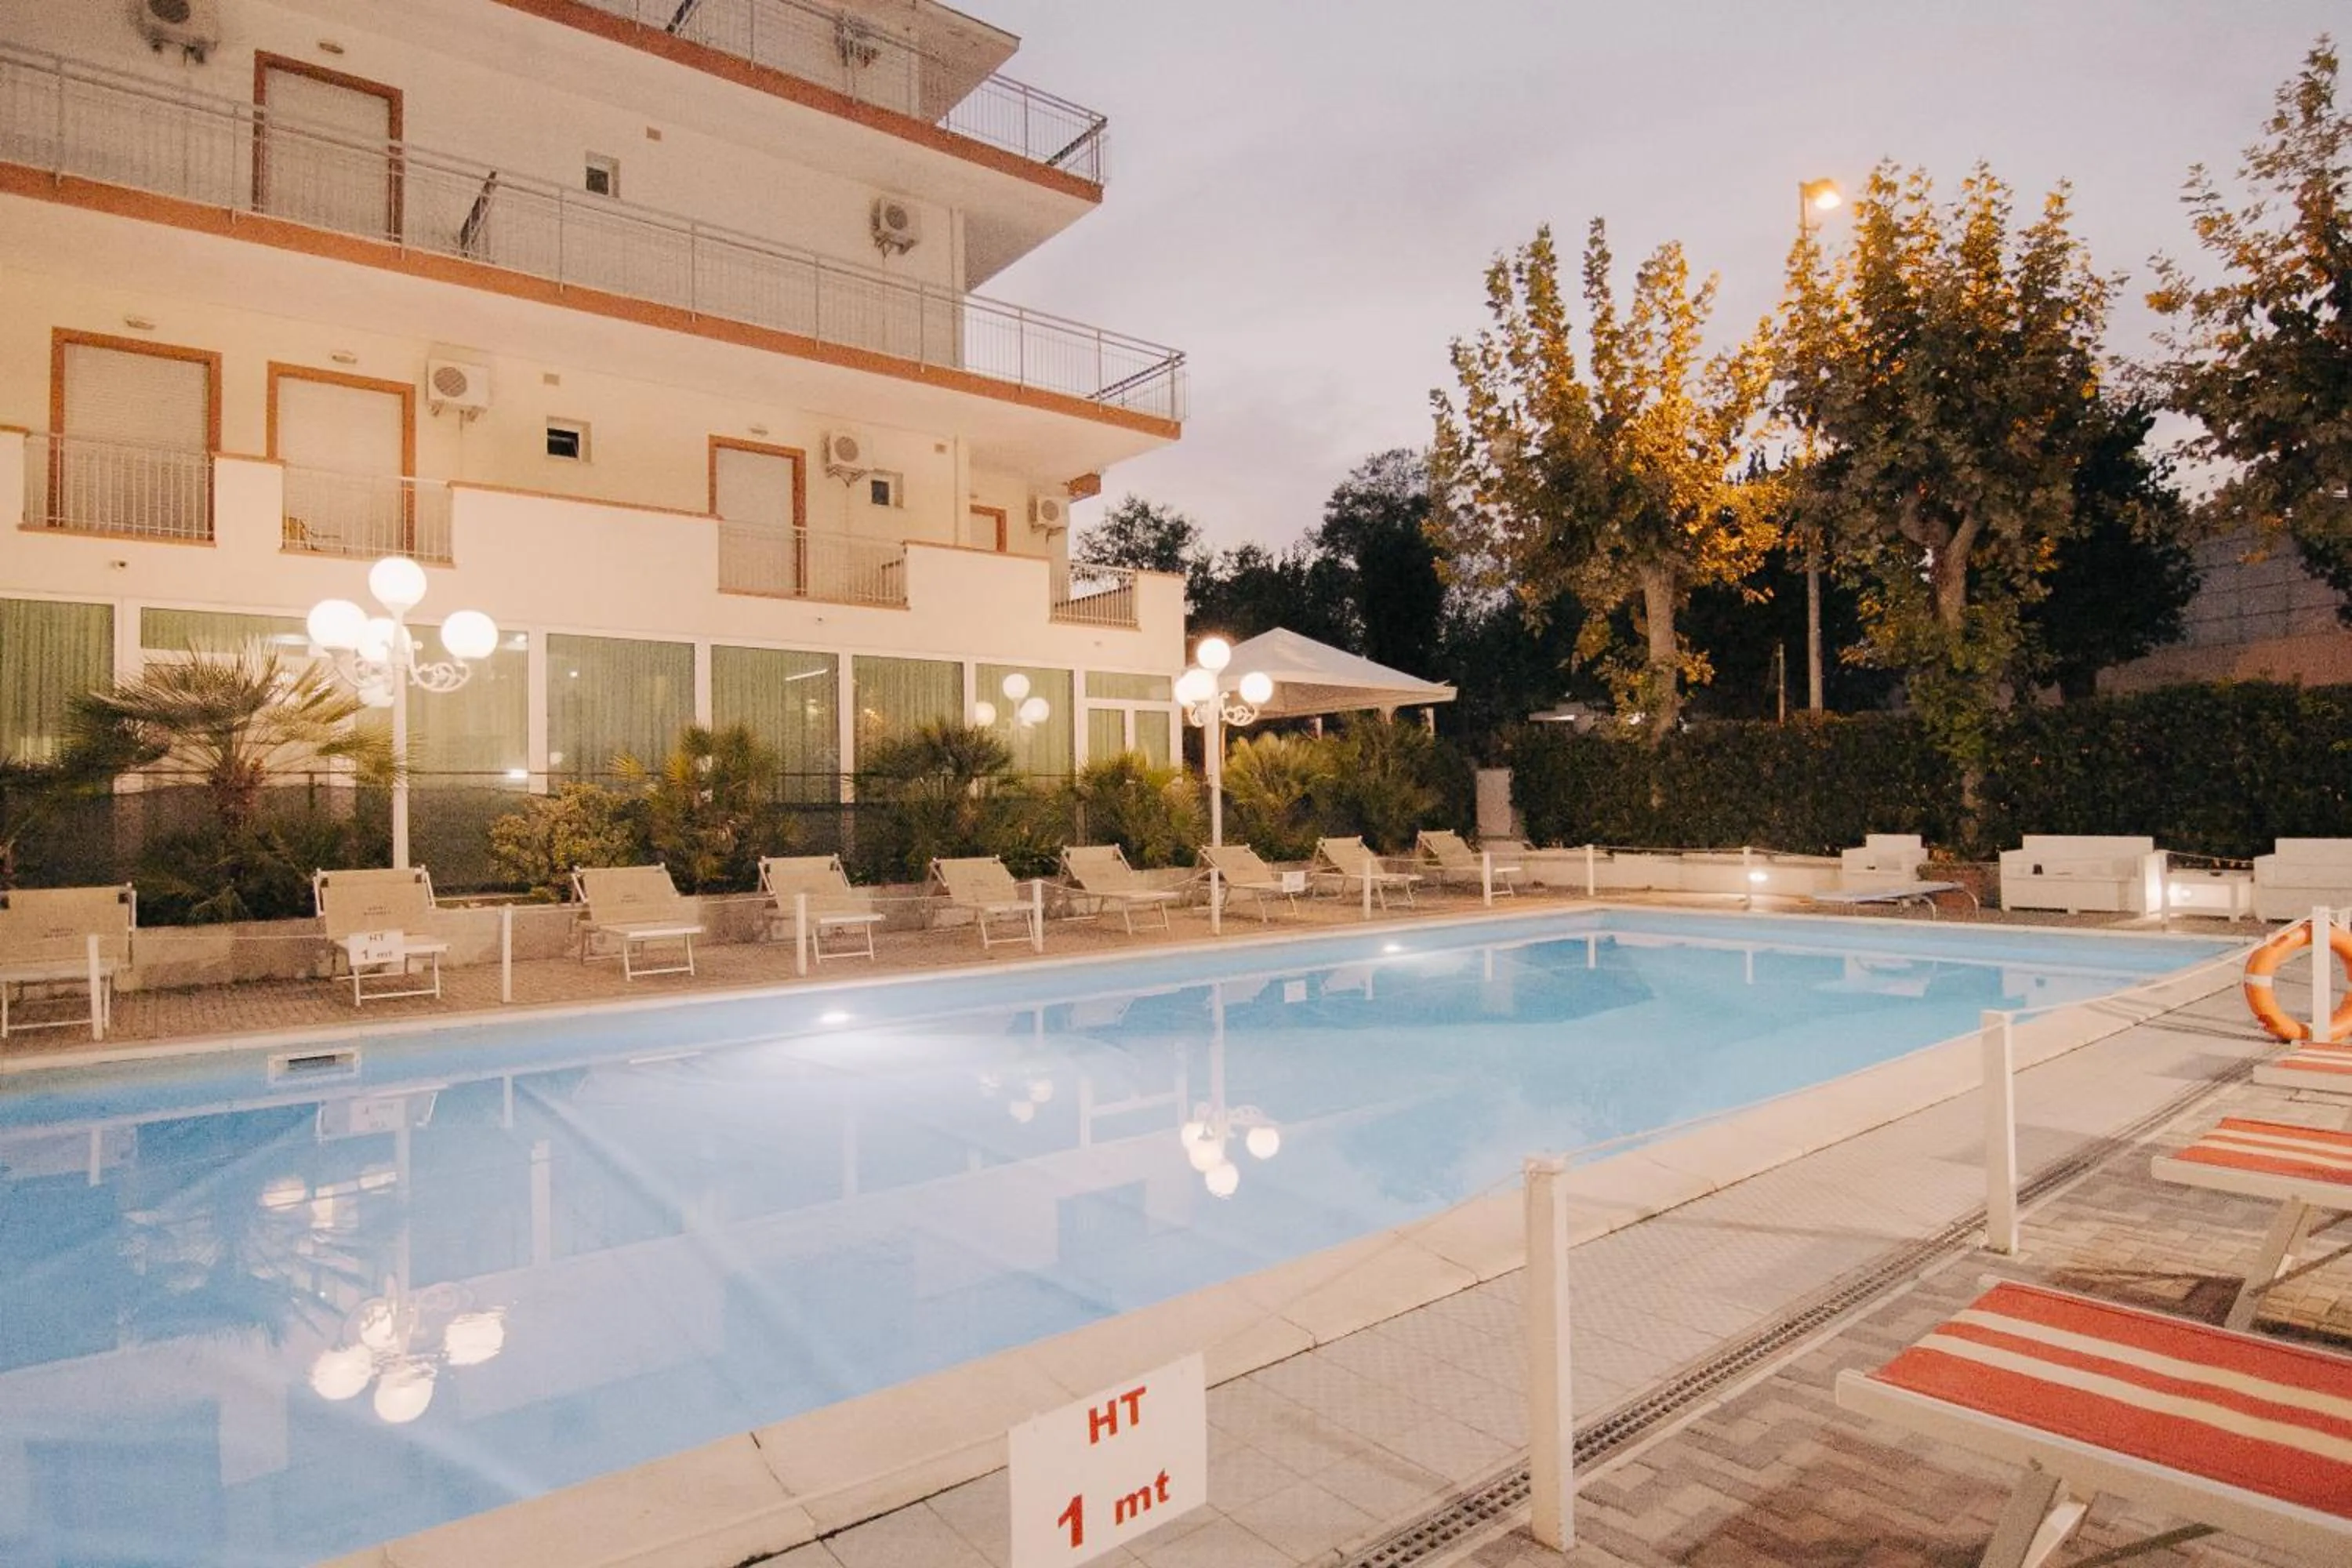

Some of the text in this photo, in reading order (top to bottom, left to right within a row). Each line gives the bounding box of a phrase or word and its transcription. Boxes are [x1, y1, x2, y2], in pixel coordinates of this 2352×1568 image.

[362, 949, 368, 960] 1
[1088, 1385, 1147, 1445] HT
[1058, 1468, 1170, 1548] 1 mt
